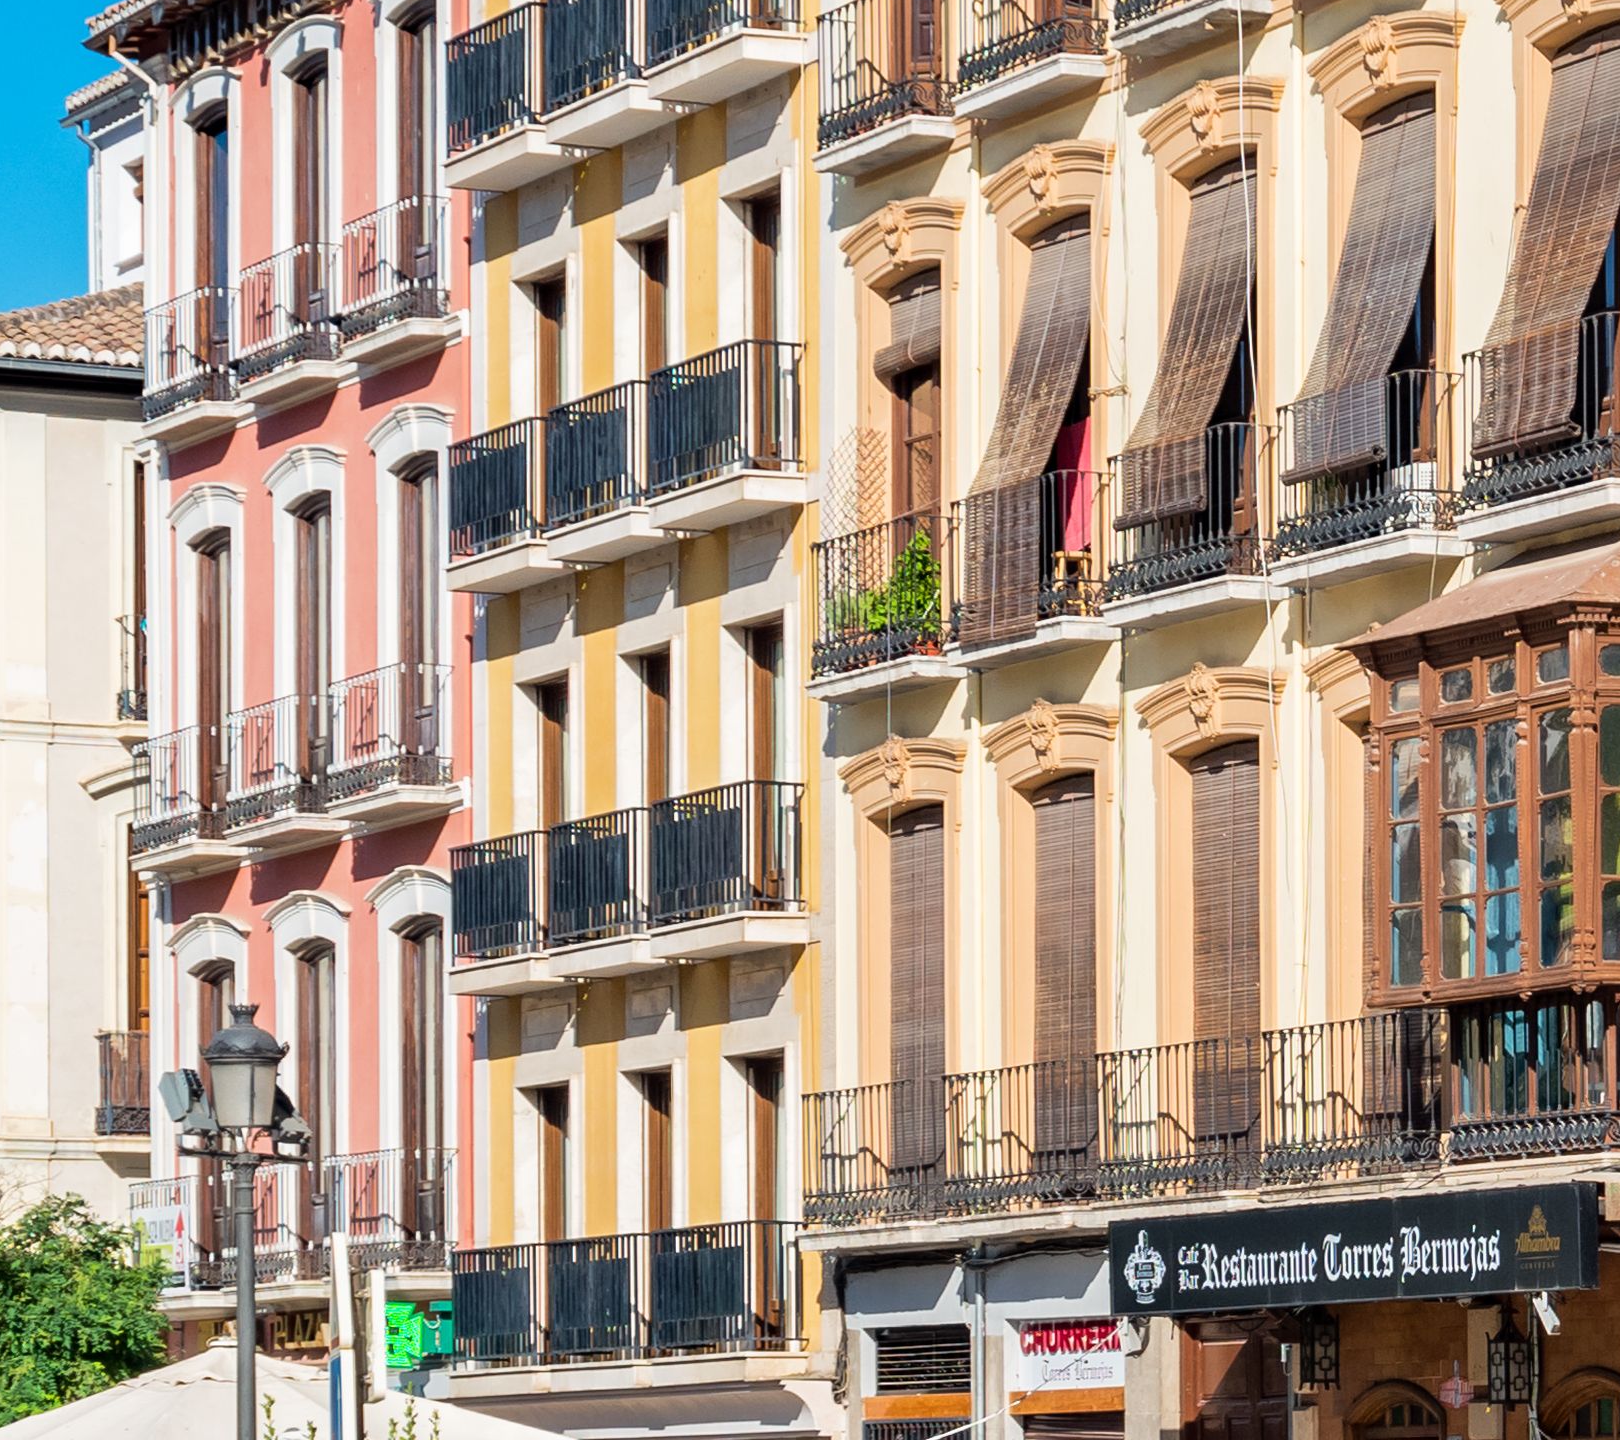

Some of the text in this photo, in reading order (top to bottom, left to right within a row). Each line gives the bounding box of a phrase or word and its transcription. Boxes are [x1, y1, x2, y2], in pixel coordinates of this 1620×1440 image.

[1201, 1224, 1501, 1291] Restaurante Torres Bermejas
[1515, 1231, 1561, 1256] Alhambra
